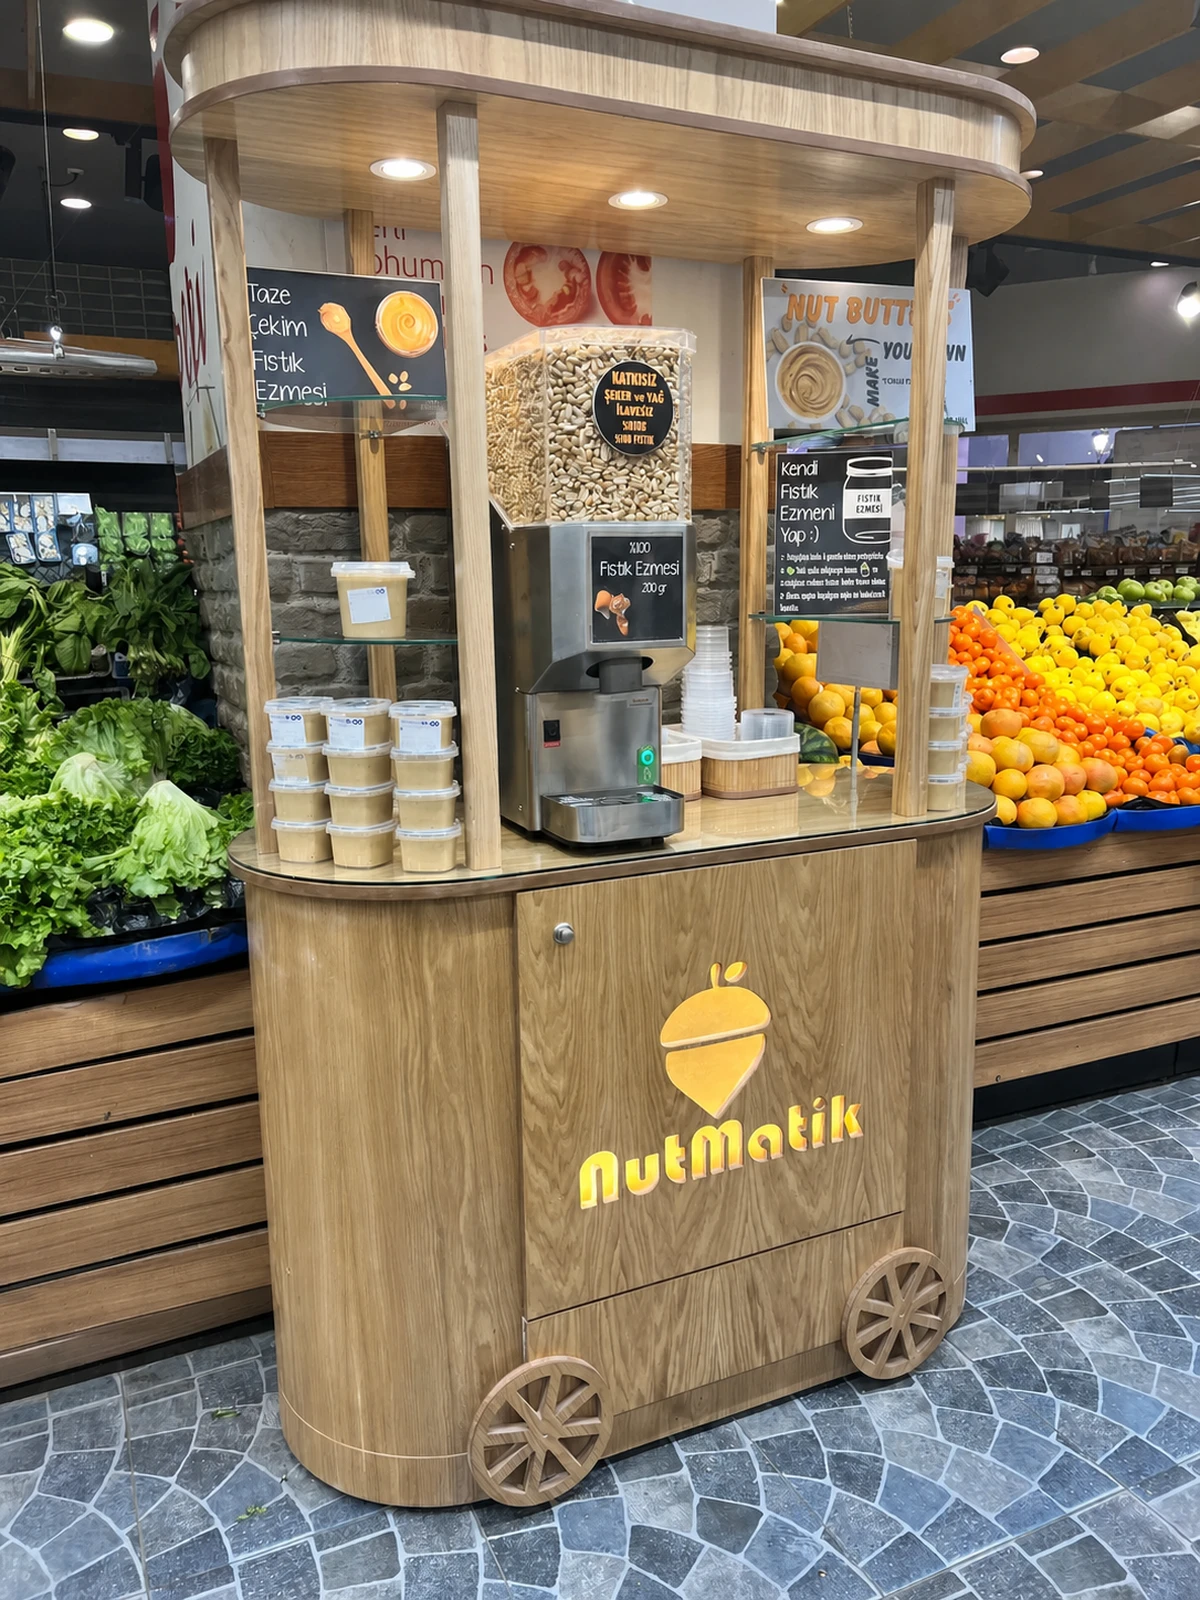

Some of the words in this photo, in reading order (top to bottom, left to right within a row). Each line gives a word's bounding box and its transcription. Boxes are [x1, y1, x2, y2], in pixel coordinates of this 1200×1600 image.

[247, 283, 291, 305] Taze
[786, 293, 839, 323] NUT
[248, 313, 307, 339] Çekim
[883, 341, 912, 361] YOU
[252, 350, 306, 373] Fıstık
[865, 356, 880, 407] MAKE
[255, 380, 328, 405] Ezmesi
[634, 394, 645, 402] ve
[646, 390, 664, 403] YAĞ
[781, 460, 819, 476] Kendi
[781, 484, 819, 499] Fıstık
[857, 494, 881, 503] FISTIK
[780, 504, 835, 521] Ezmeni
[780, 527, 806, 547] Yap
[600, 561, 633, 576] Fıstık
[636, 560, 680, 576] Ezmesi
[642, 582, 657, 593] 200
[658, 584, 667, 596] gr
